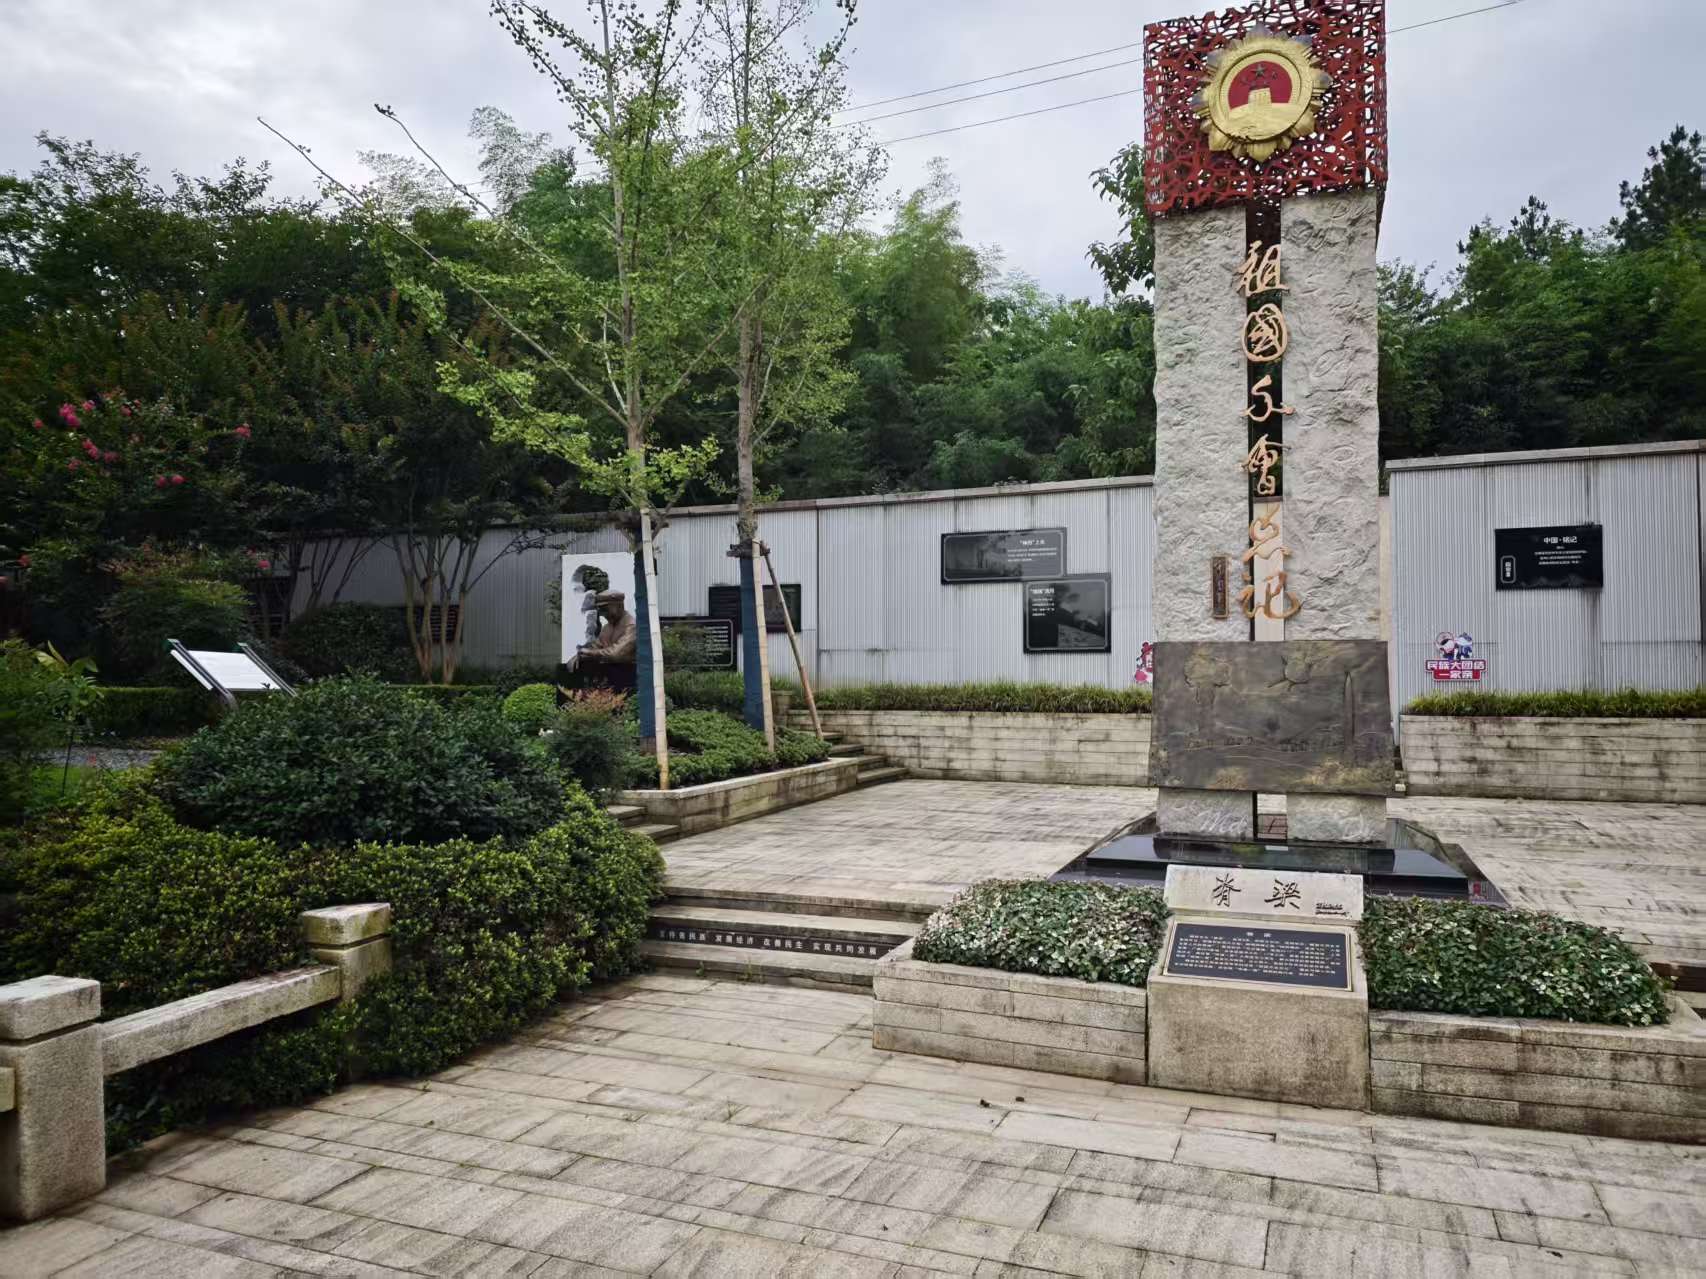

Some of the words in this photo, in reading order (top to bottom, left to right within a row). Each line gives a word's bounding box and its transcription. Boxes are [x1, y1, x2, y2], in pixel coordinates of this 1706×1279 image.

[1427, 660, 1485, 670] 民族大团结
[1438, 670, 1473, 679] 一家亲
[1211, 873, 1302, 910] 脊梁
